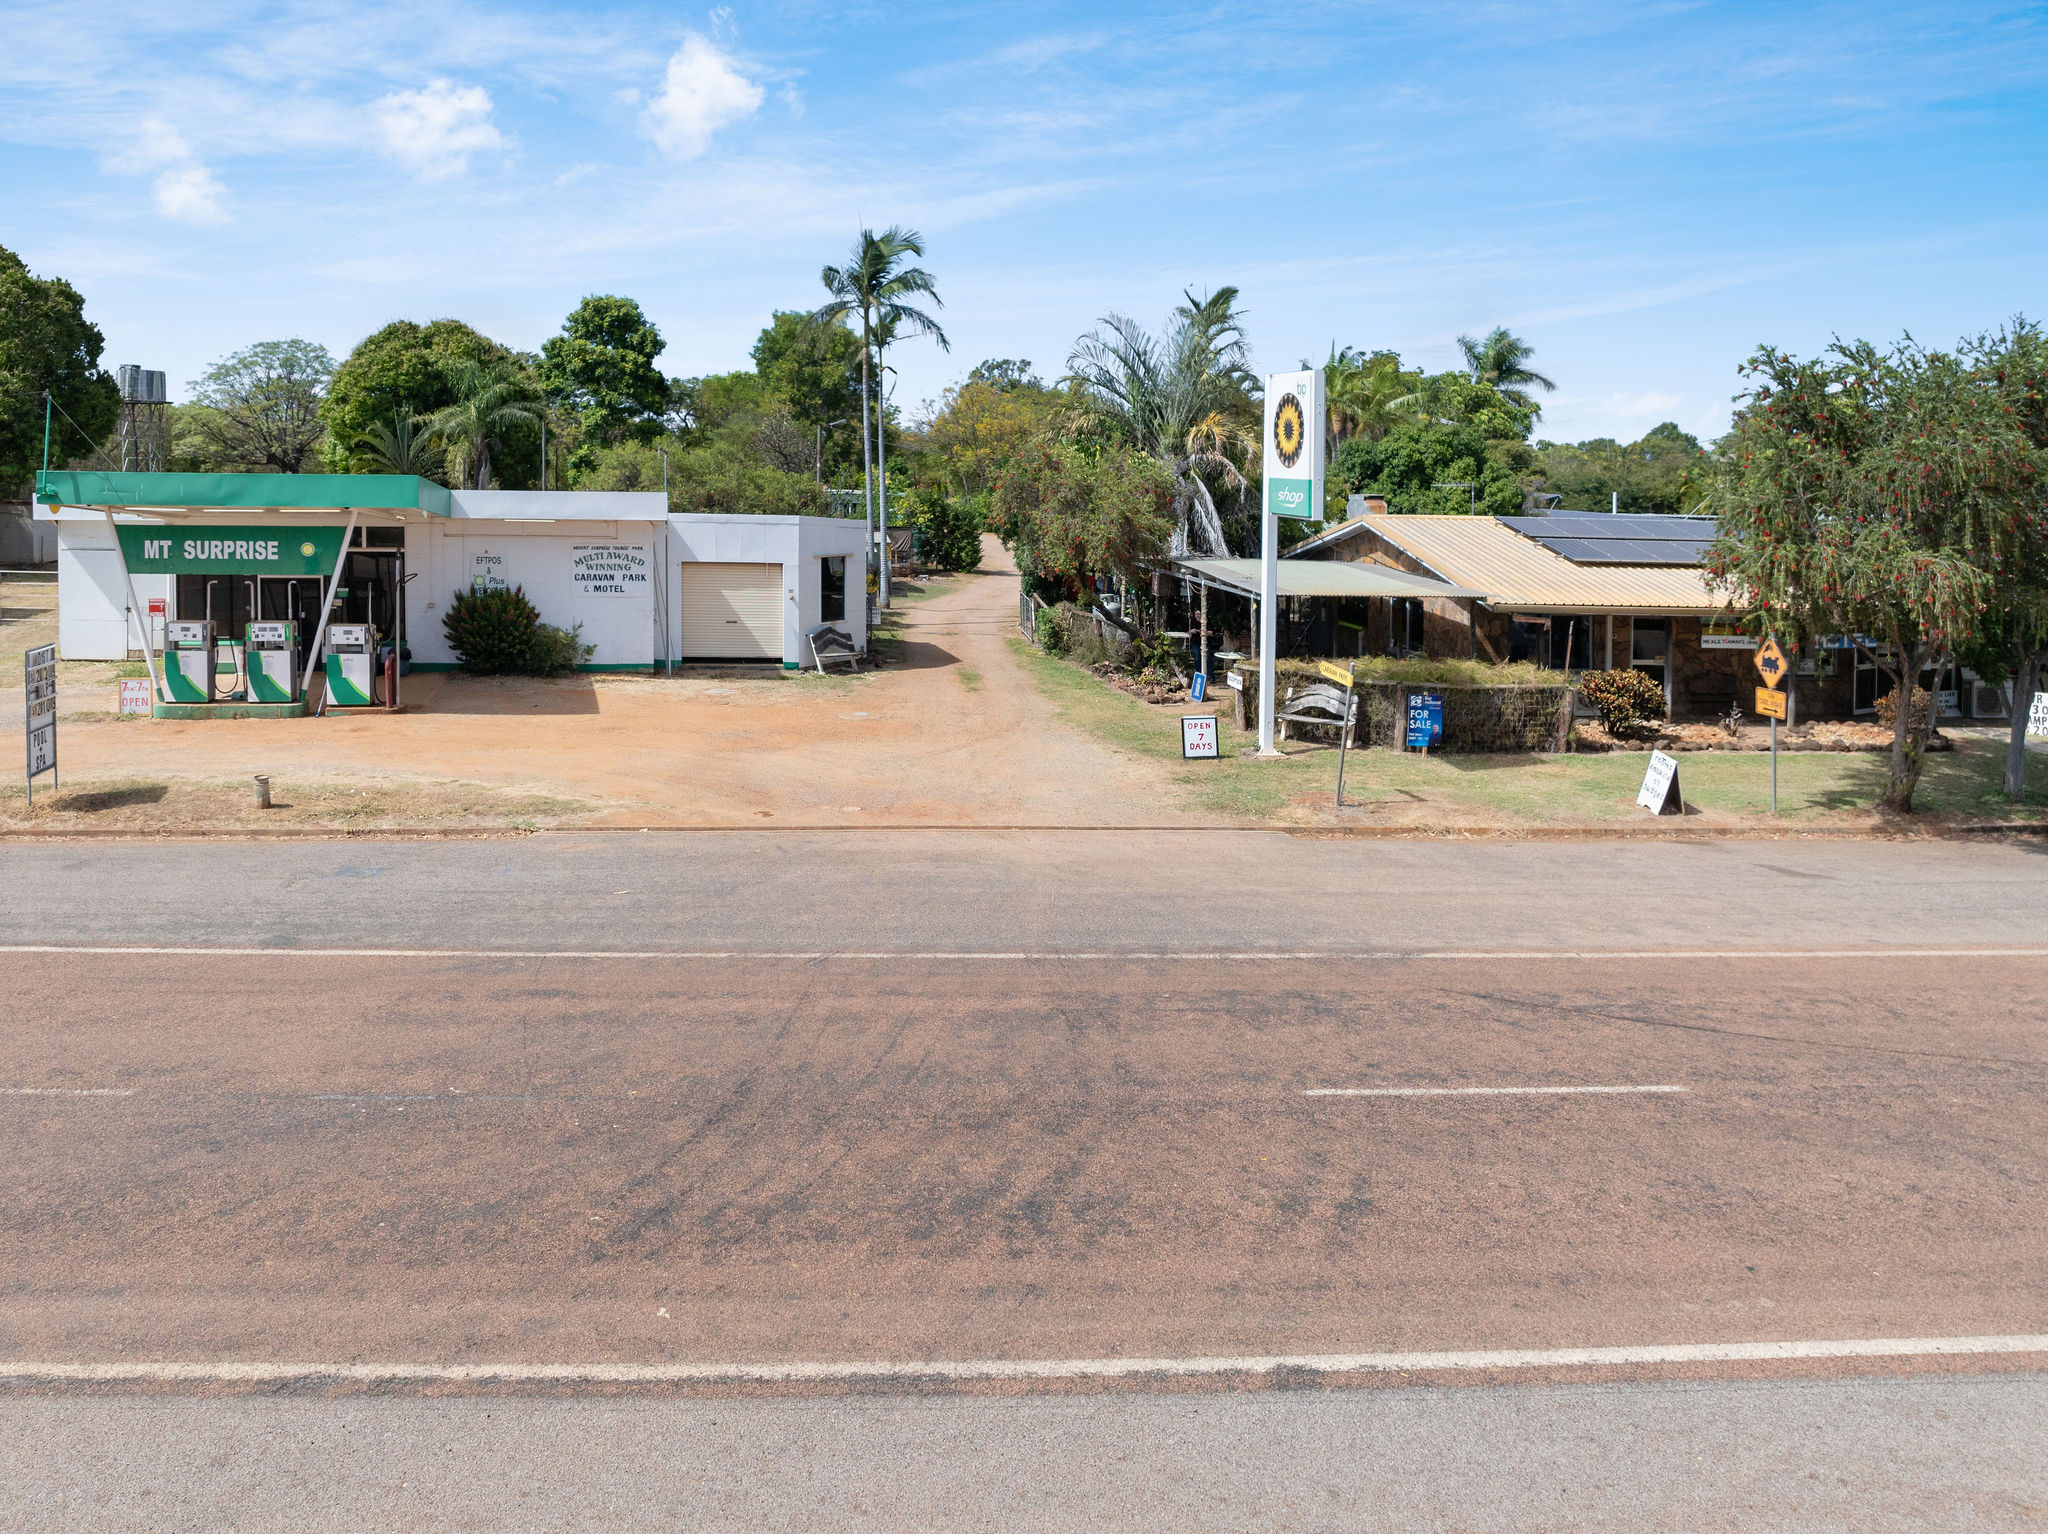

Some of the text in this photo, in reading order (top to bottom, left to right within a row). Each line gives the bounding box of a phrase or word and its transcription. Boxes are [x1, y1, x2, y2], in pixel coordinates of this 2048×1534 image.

[1297, 381, 1307, 398] bp
[1278, 486, 1304, 507] shop
[144, 540, 279, 560] MT SURPRISE
[476, 556, 502, 565] EFTPOS
[574, 552, 645, 567] MULTI AWARD
[486, 566, 492, 575] &
[585, 563, 632, 571] WINNING
[488, 577, 506, 585] Plus
[574, 573, 647, 581] CARAVAN PARK
[593, 585, 625, 593] MOTEL
[122, 697, 149, 707] OPEN
[1410, 709, 1429, 719] FOR
[1187, 722, 1211, 730] OPEN
[1409, 720, 1432, 729] SALE
[33, 729, 47, 748] POOL
[1198, 733, 1205, 741] 7
[36, 753, 47, 770] SPA
